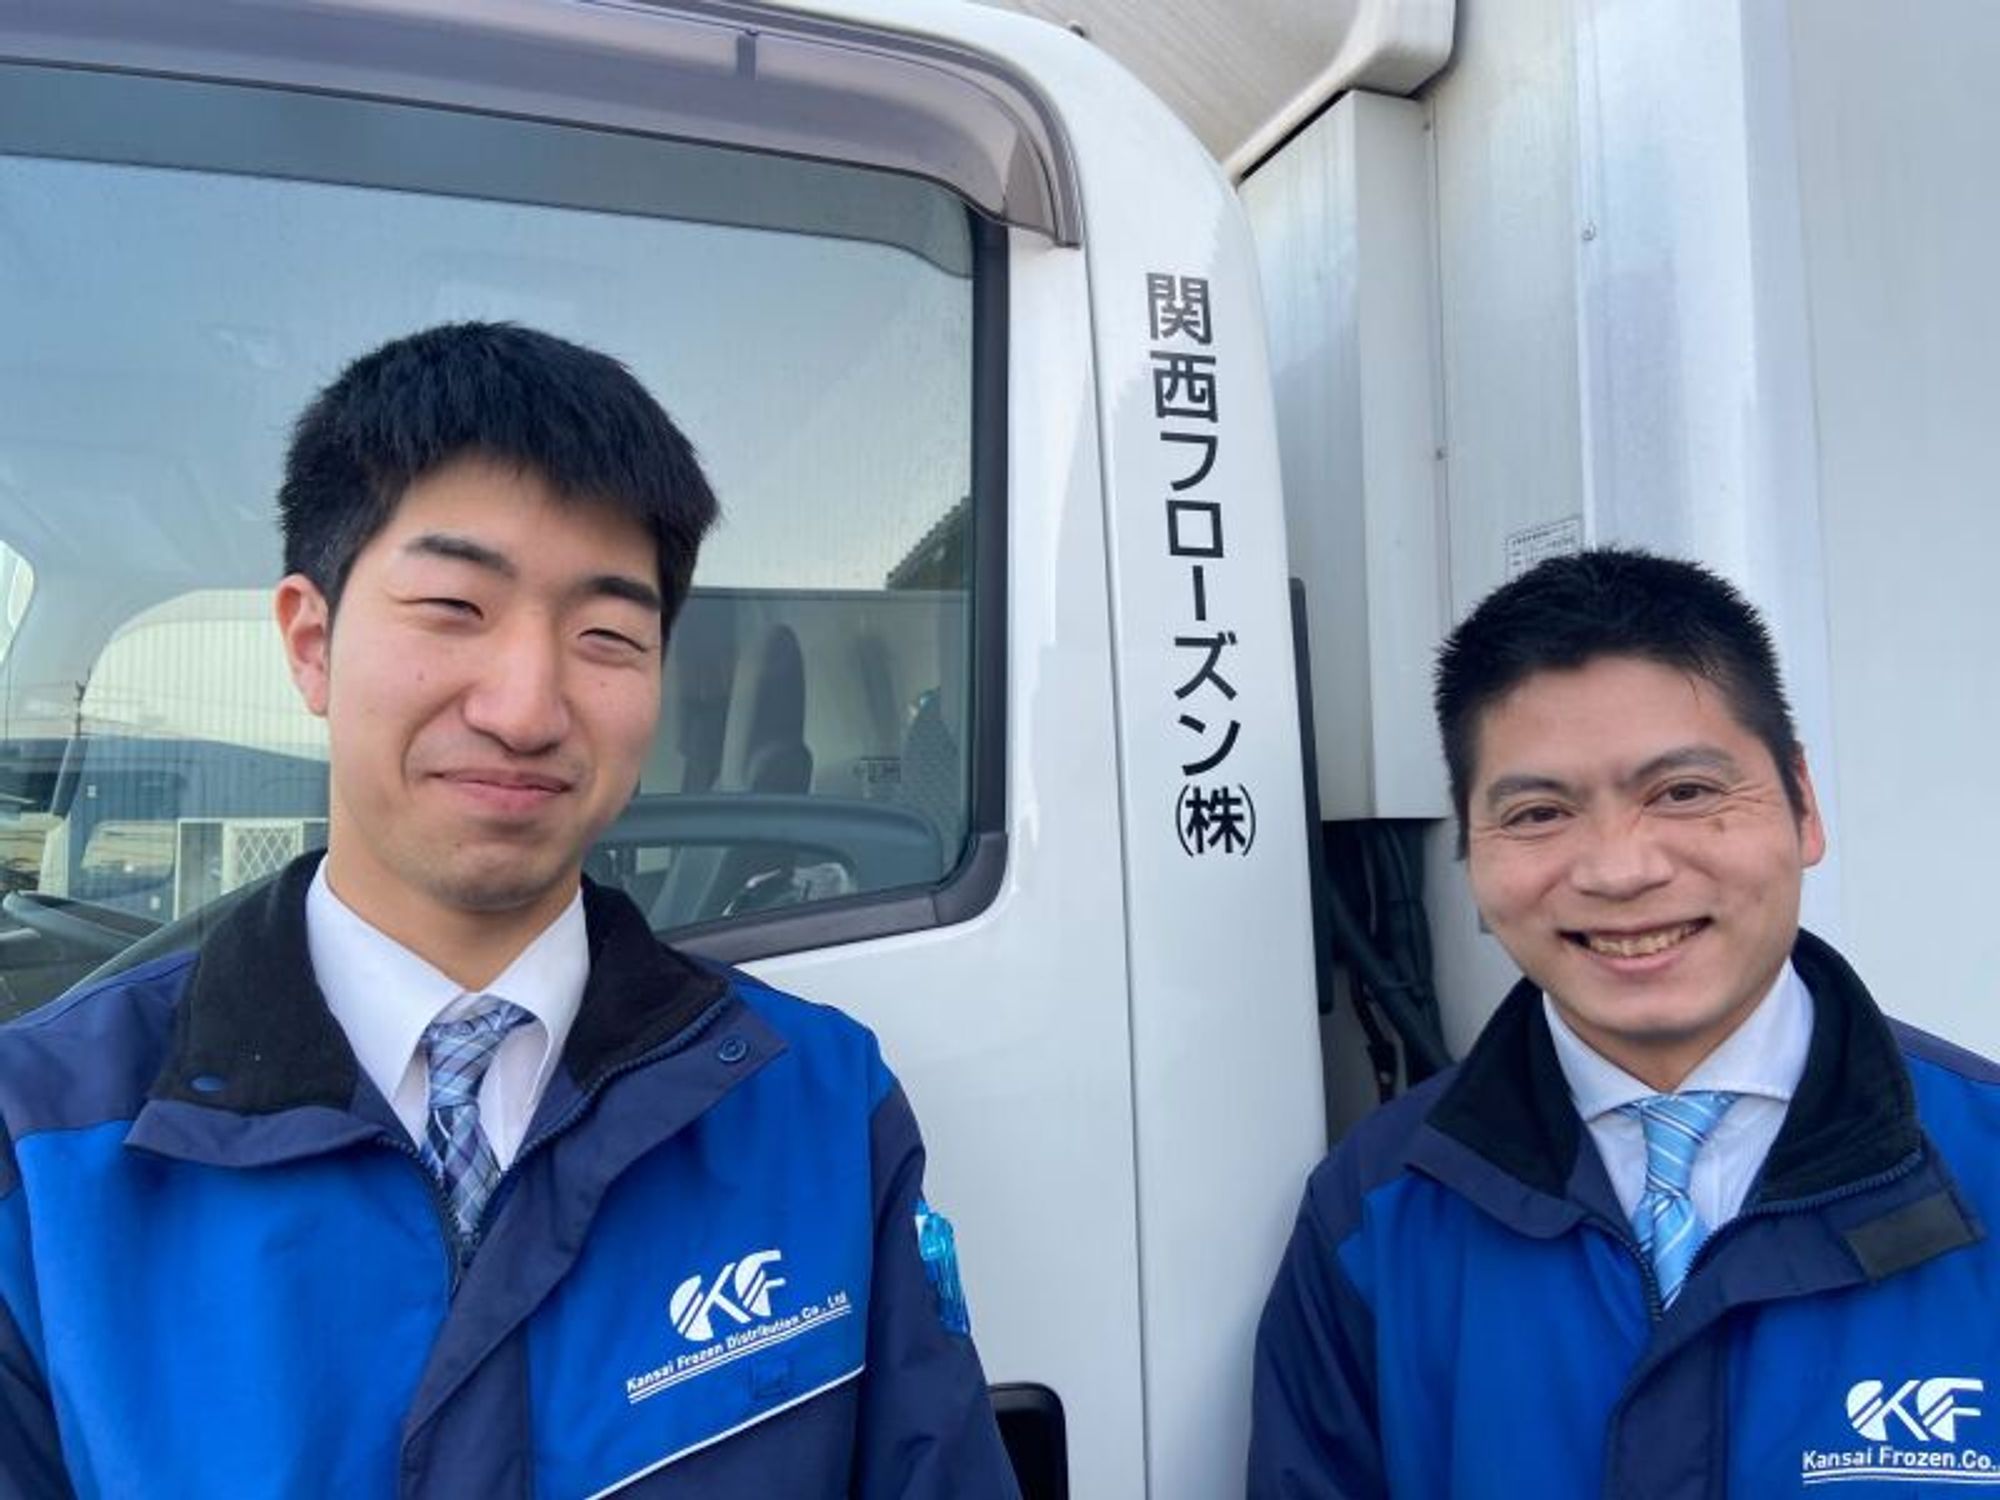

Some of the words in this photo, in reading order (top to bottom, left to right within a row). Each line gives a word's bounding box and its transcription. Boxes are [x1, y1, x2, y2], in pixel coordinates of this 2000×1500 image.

[1145, 271, 1256, 856] 関西フローズン(株)
[626, 1359, 675, 1393] Kansai
[676, 1343, 725, 1370] Frozen
[725, 1314, 800, 1348] Distribution
[1802, 1447, 1873, 1471] Kansai
